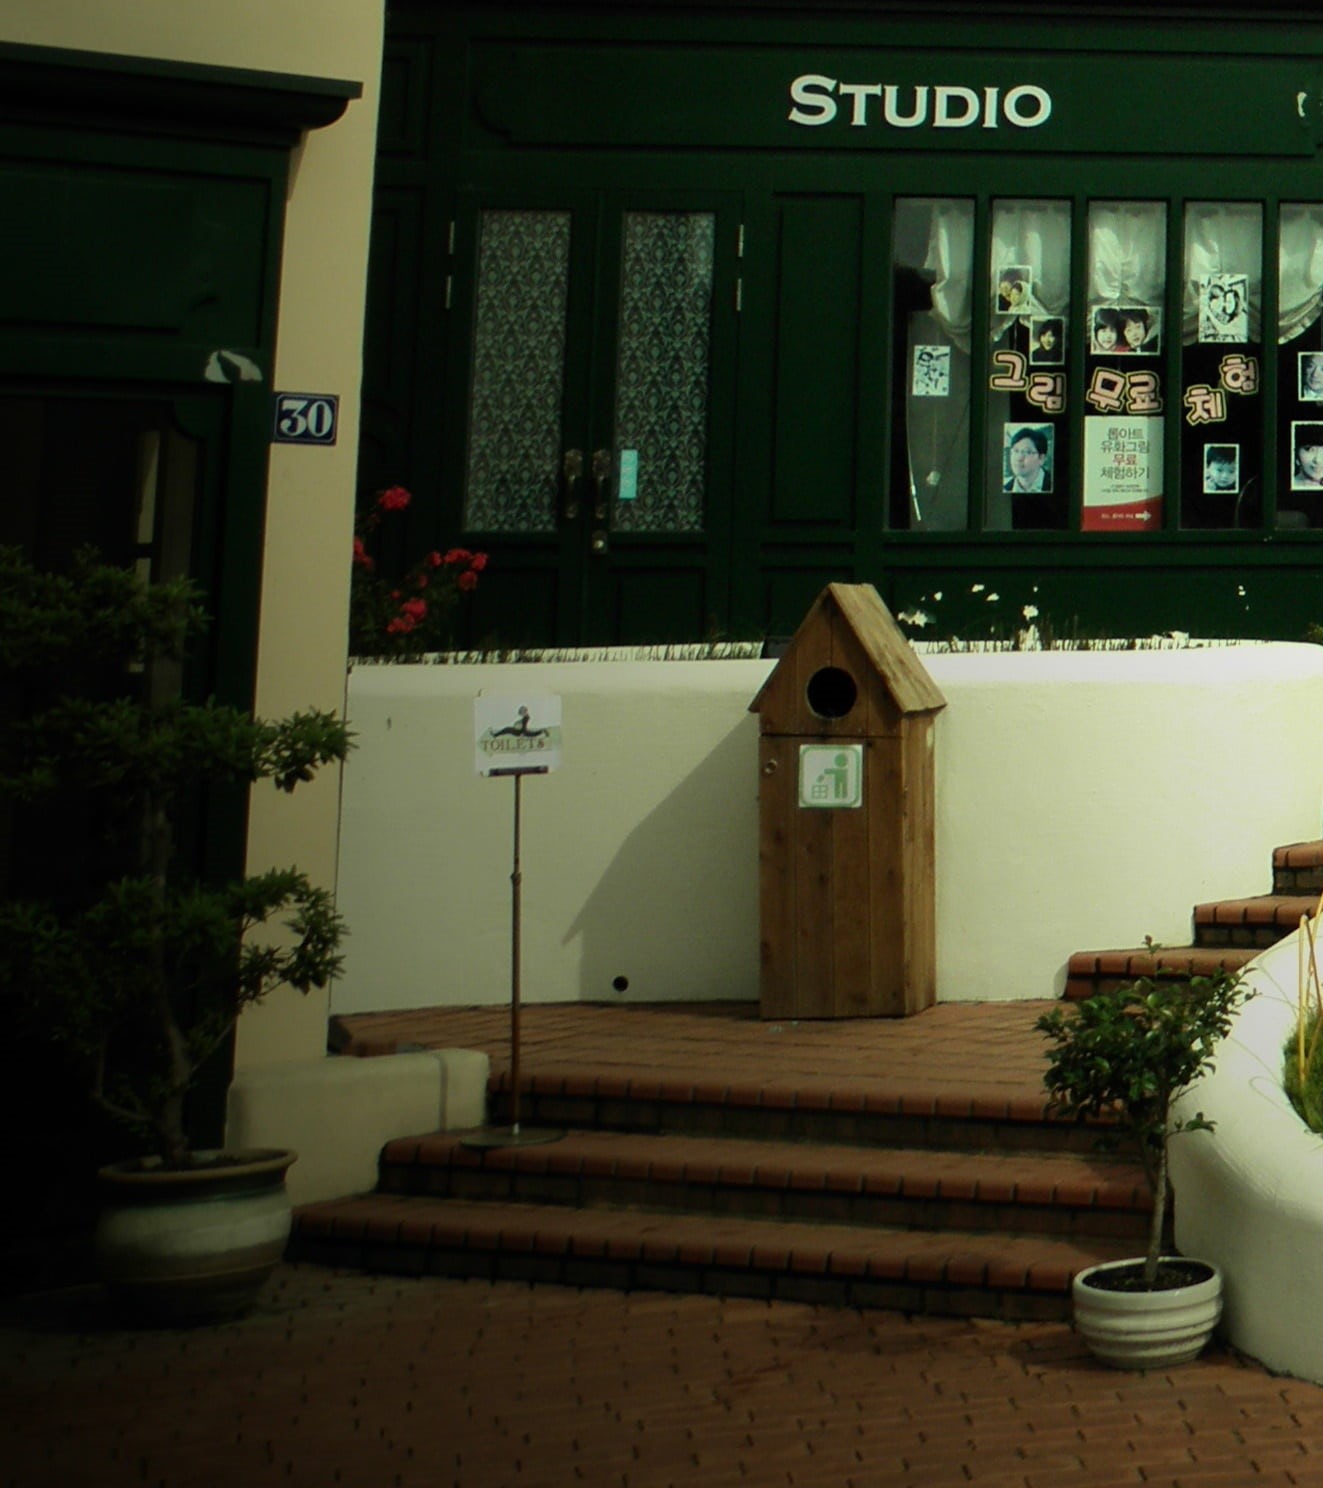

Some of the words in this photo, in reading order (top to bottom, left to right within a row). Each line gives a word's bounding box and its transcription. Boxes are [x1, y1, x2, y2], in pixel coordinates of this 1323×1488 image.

[788, 74, 1052, 129] STUDIO
[991, 351, 1066, 413] 그림
[1086, 367, 1163, 414] 무료
[1184, 354, 1259, 426] 체험
[280, 399, 333, 438] 30
[1101, 440, 1150, 454] 유화그림
[1113, 454, 1137, 466] 무료
[1100, 466, 1150, 480] 체험하기
